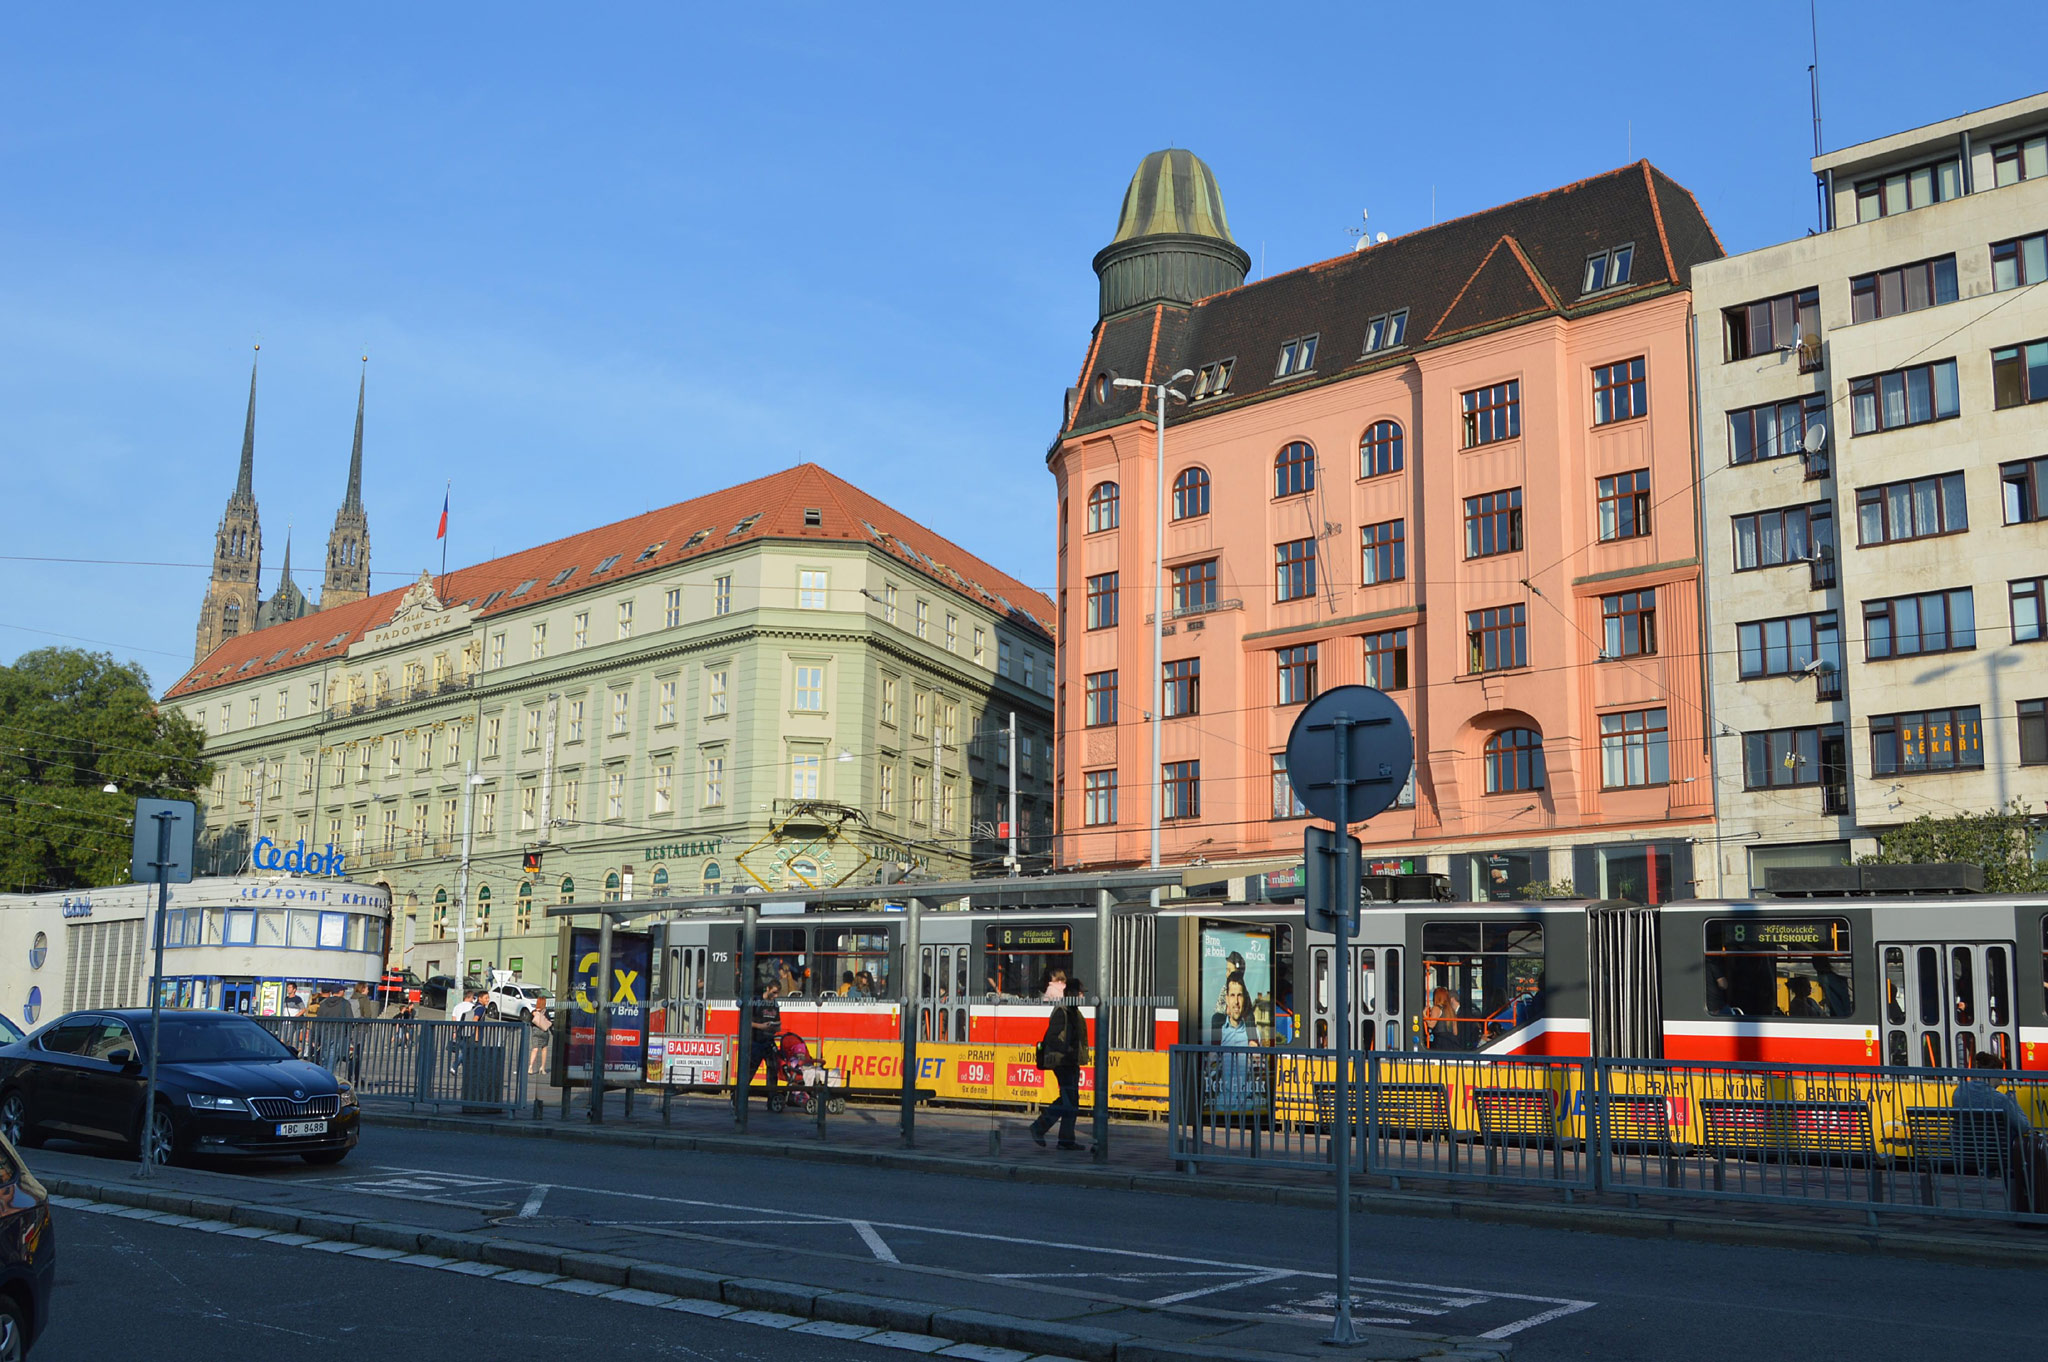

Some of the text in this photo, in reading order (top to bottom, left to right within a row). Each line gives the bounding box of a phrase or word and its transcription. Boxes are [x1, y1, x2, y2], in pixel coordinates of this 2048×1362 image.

[402, 611, 425, 623] PALÁC
[375, 615, 451, 642] PADOWETZ
[1903, 720, 1978, 741] DĚTŠTÍ
[1906, 737, 1978, 755] LÉKAŘI
[253, 836, 347, 877] Čedok
[645, 840, 722, 862] RESTAURANT
[1375, 866, 1407, 876] mBank
[1271, 875, 1301, 885] mBank
[241, 887, 326, 902] CESTOVNÍ
[1004, 930, 1012, 944] 8
[1734, 925, 1745, 942] 8
[712, 952, 728, 963] 1715
[611, 1006, 639, 1017] v Brně
[668, 1042, 721, 1054] BAUHAUS
[967, 1049, 995, 1061] PRAHY
[852, 1055, 946, 1081] REGIJET
[969, 1064, 984, 1081] 99
[1017, 1068, 1035, 1083] 175
[1019, 1088, 1038, 1098] denně
[1647, 1081, 1689, 1096] PRAHY
[1807, 1086, 1893, 1103] BRATISLAVY
[283, 1122, 324, 1134] 1BC 8488
